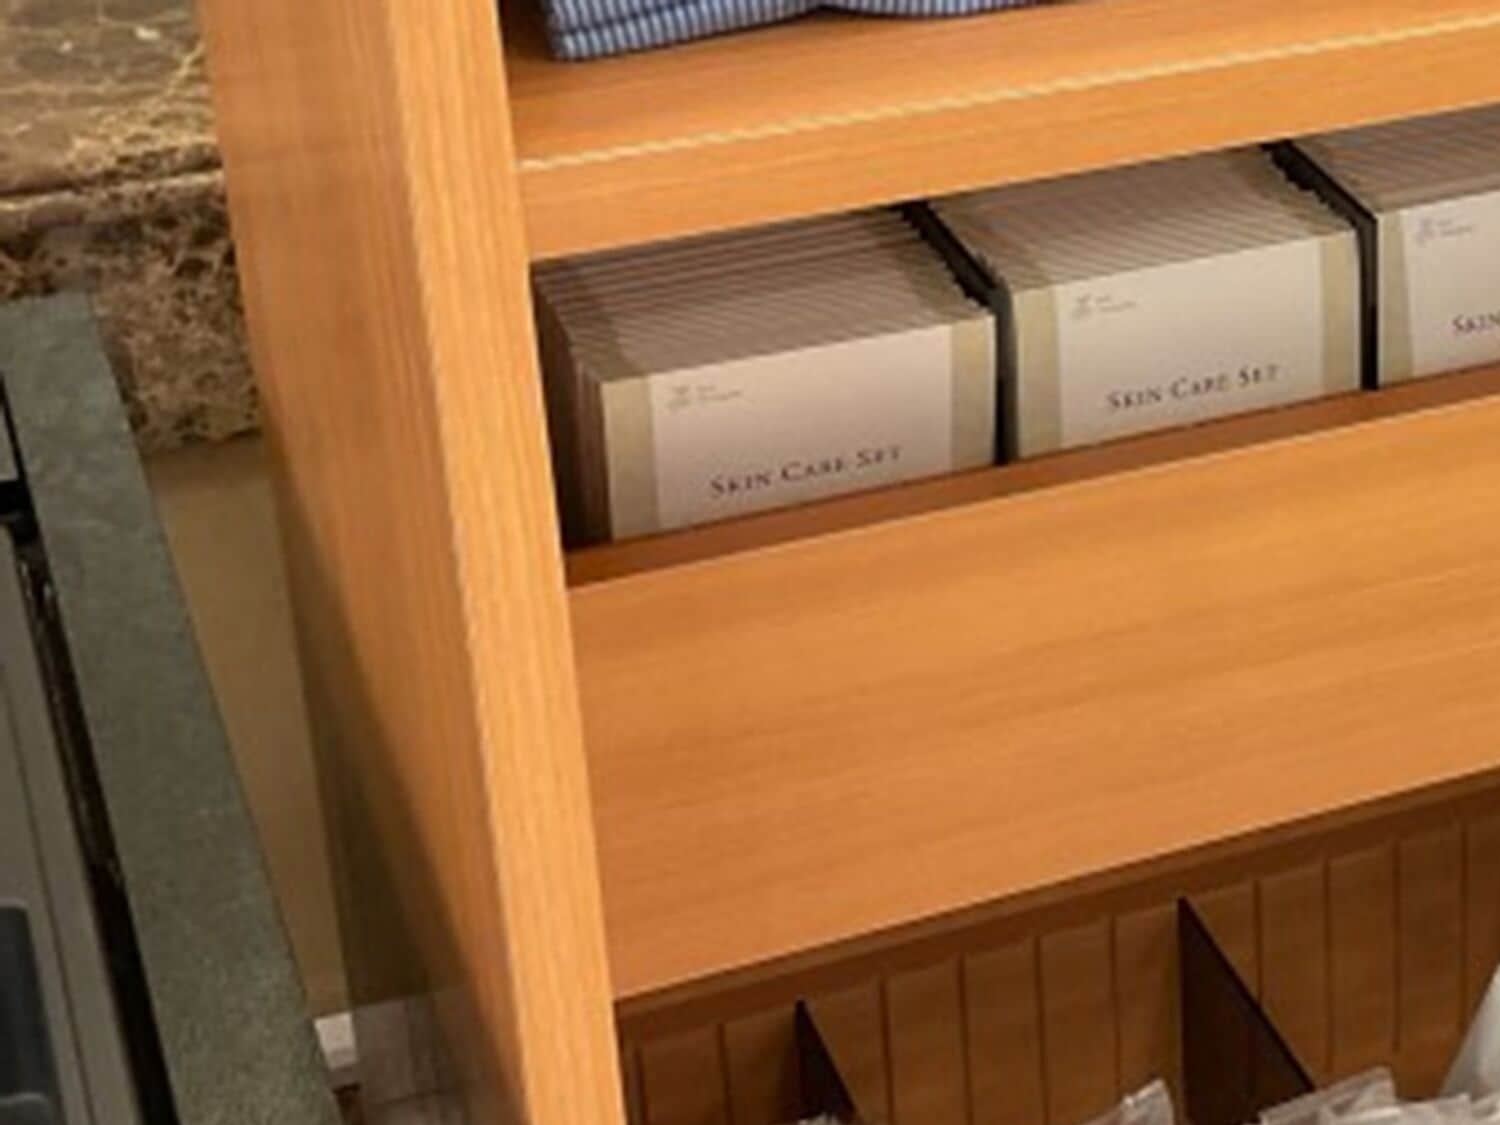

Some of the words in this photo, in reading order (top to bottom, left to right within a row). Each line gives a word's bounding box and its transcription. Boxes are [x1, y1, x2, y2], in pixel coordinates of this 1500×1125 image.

[1107, 384, 1163, 410] SKIN
[1237, 363, 1282, 388] SET
[708, 470, 774, 499] SKIN
[856, 444, 901, 468] SET
